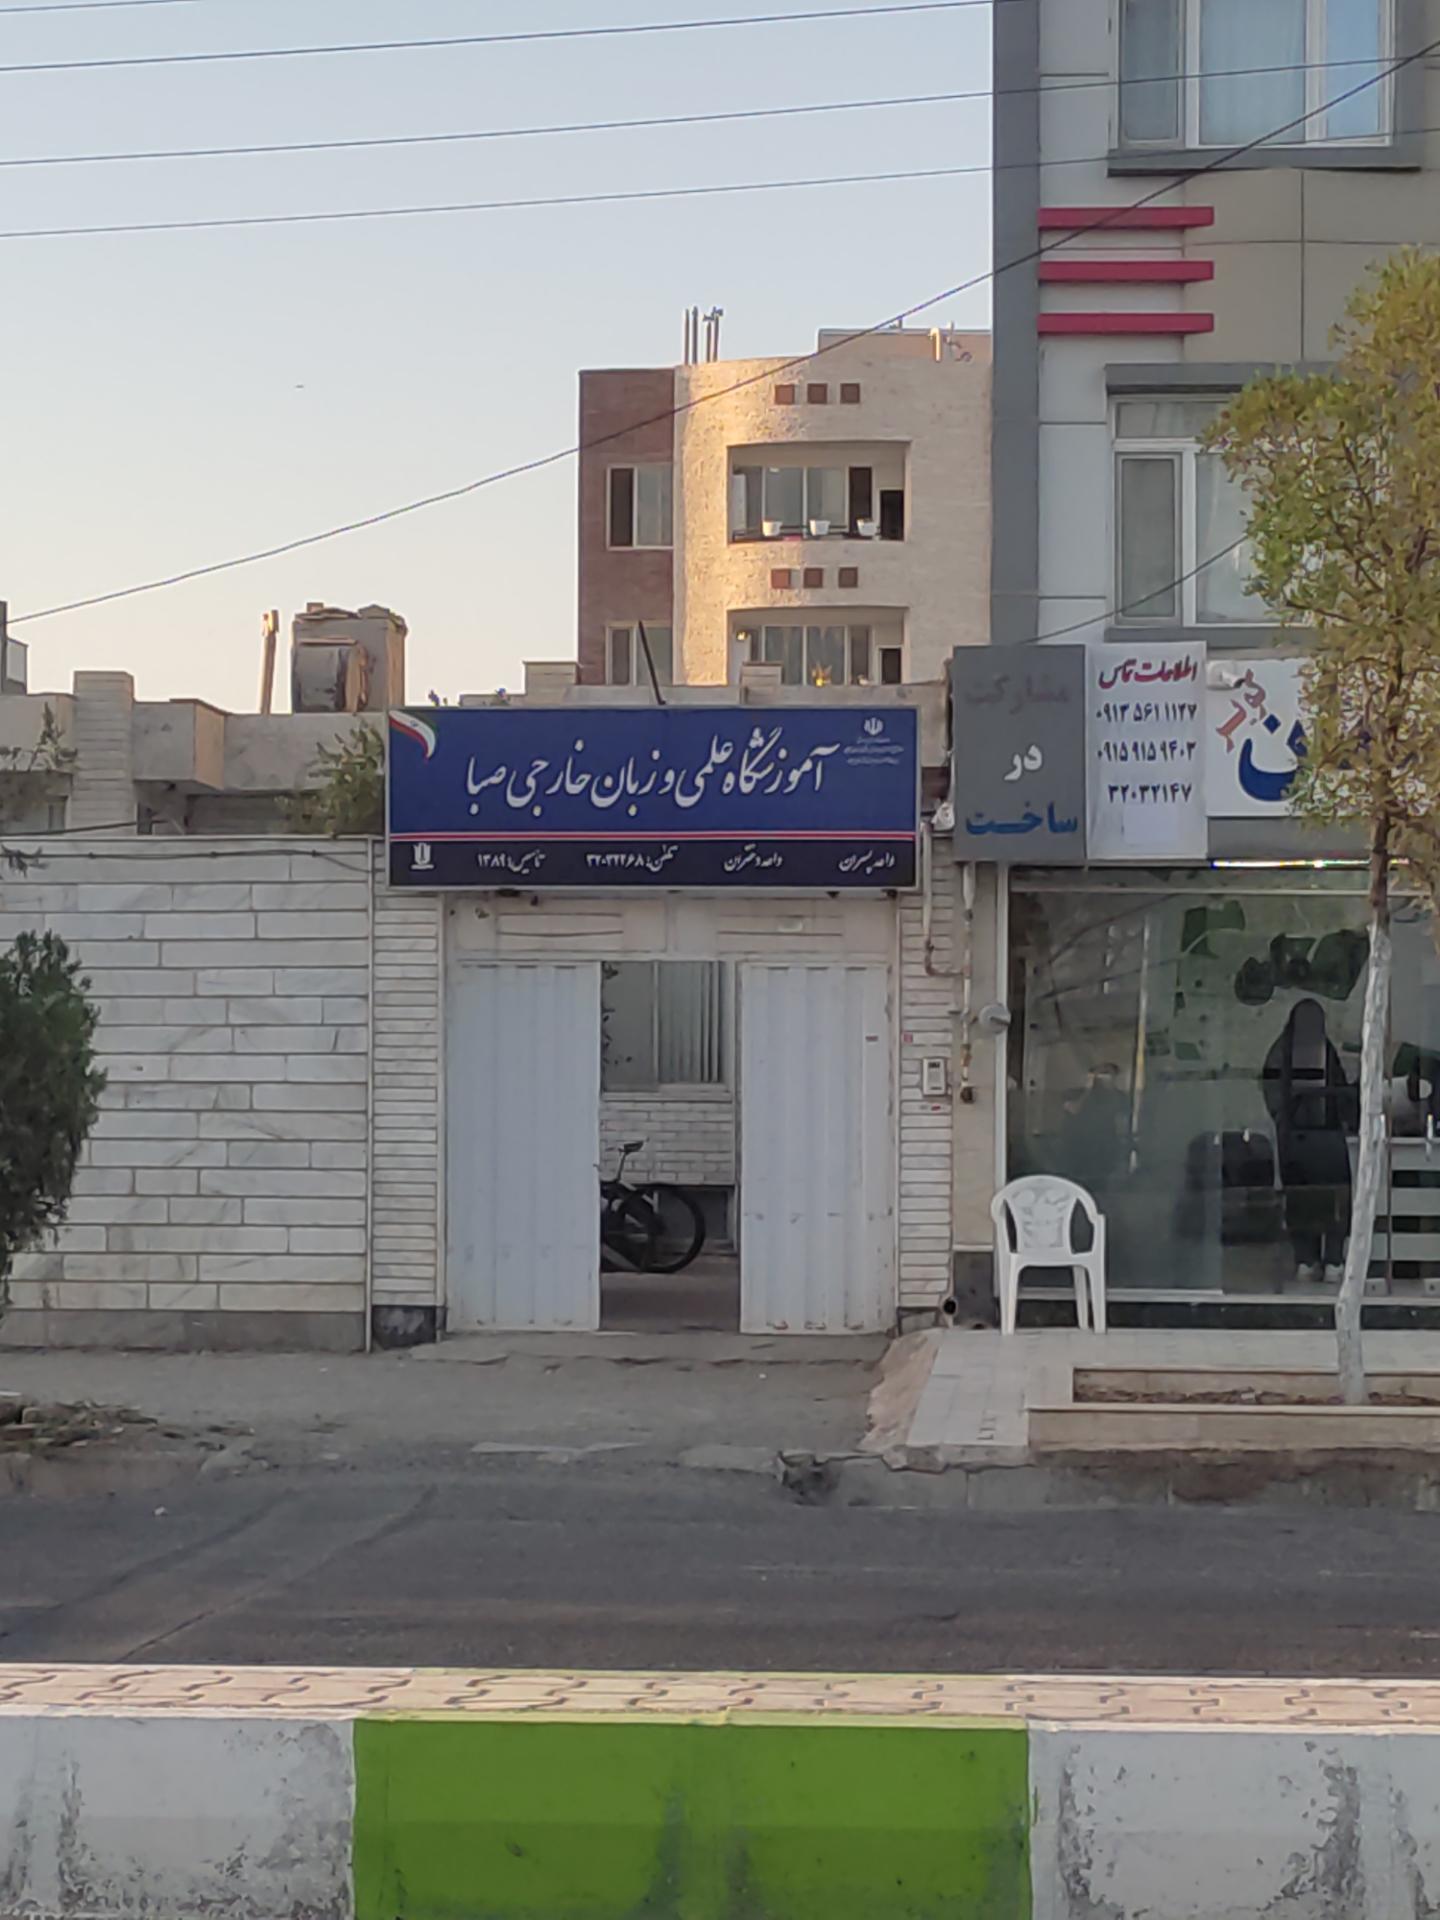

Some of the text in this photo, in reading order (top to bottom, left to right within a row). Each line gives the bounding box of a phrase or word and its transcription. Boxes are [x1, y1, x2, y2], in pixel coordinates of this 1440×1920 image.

[467, 757, 507, 815] صبا
[506, 739, 592, 817] خارجی
[590, 750, 660, 817] زبان
[674, 734, 733, 808] علمی
[721, 726, 841, 794] آموزشگاه
[1004, 744, 1043, 781] در
[965, 801, 1078, 835] ساخت
[838, 850, 873, 874] پسران
